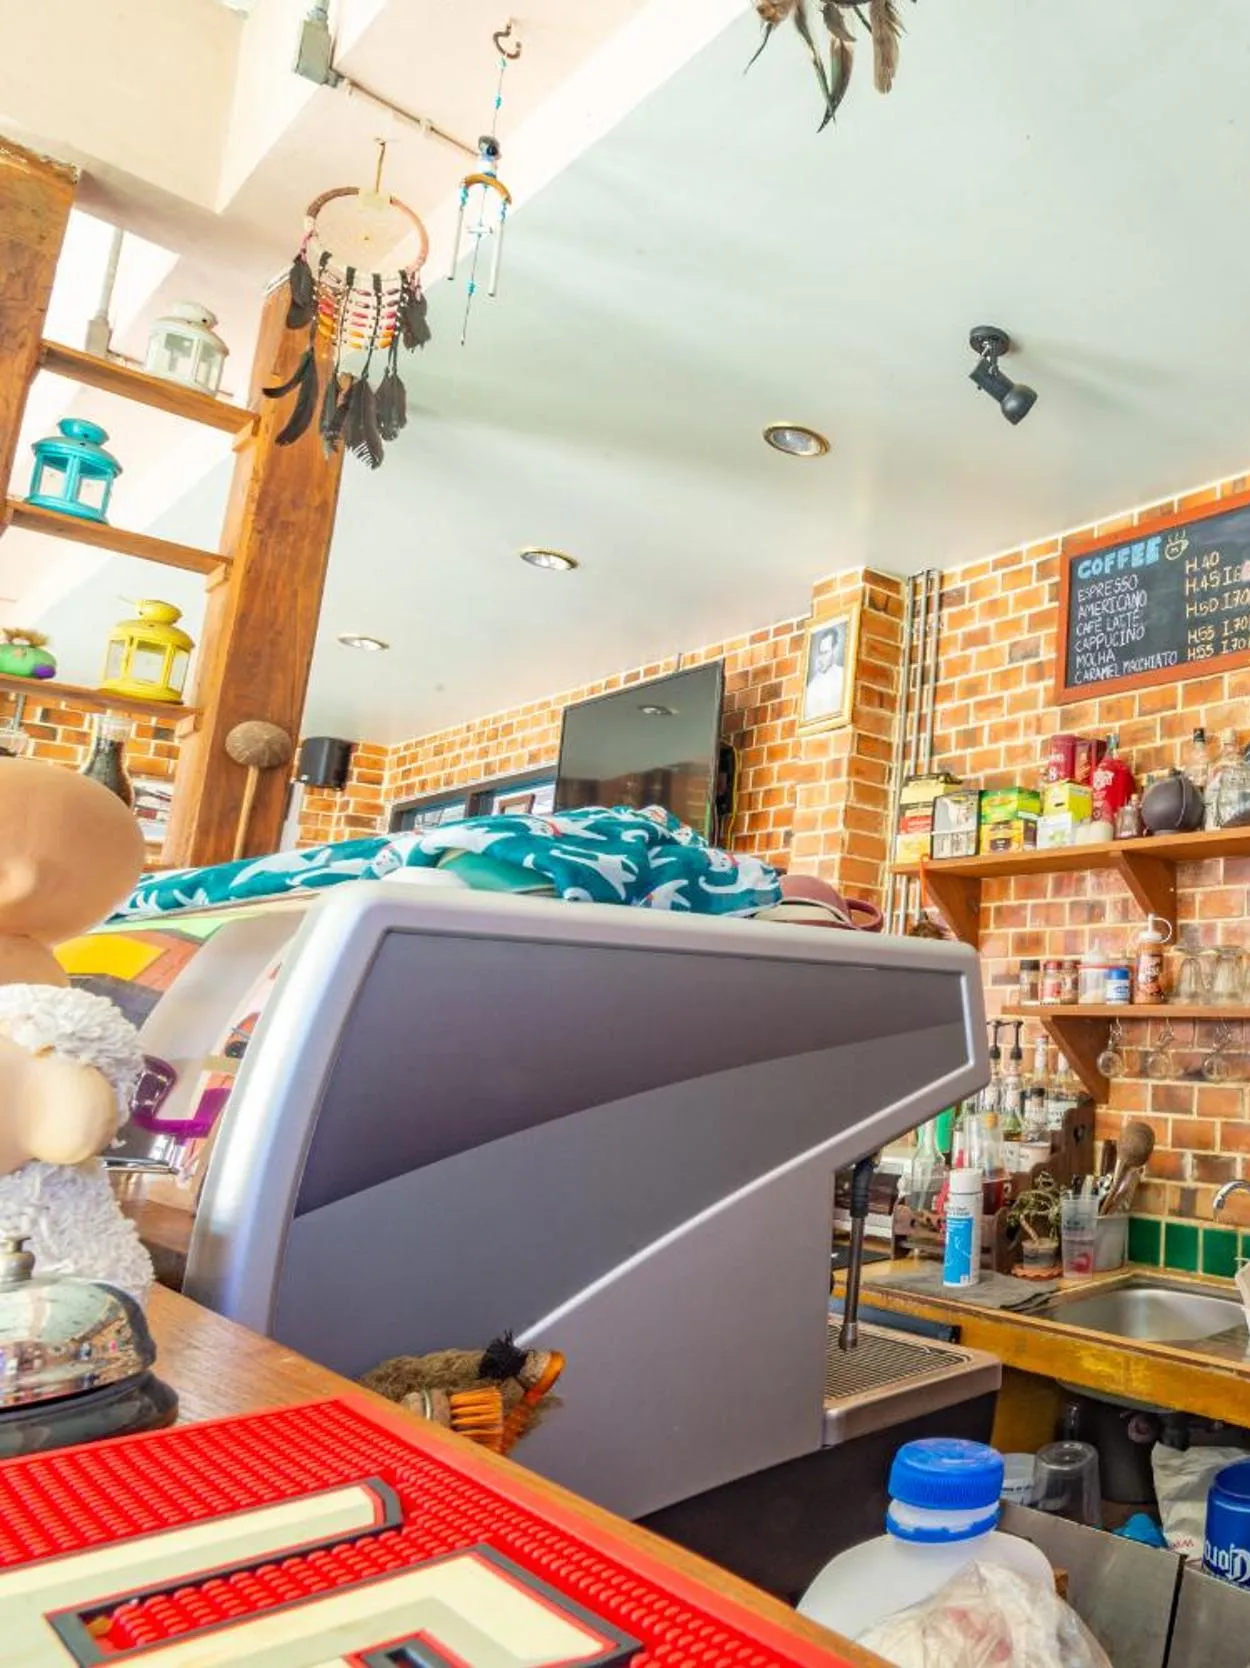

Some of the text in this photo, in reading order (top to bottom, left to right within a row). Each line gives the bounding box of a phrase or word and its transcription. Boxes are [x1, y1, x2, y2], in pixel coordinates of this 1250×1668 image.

[1077, 536, 1162, 579] COFFEE
[1077, 574, 1139, 602] ESPRESSO
[1077, 590, 1148, 620] AMERICANO
[1076, 649, 1116, 669] MOCHA
